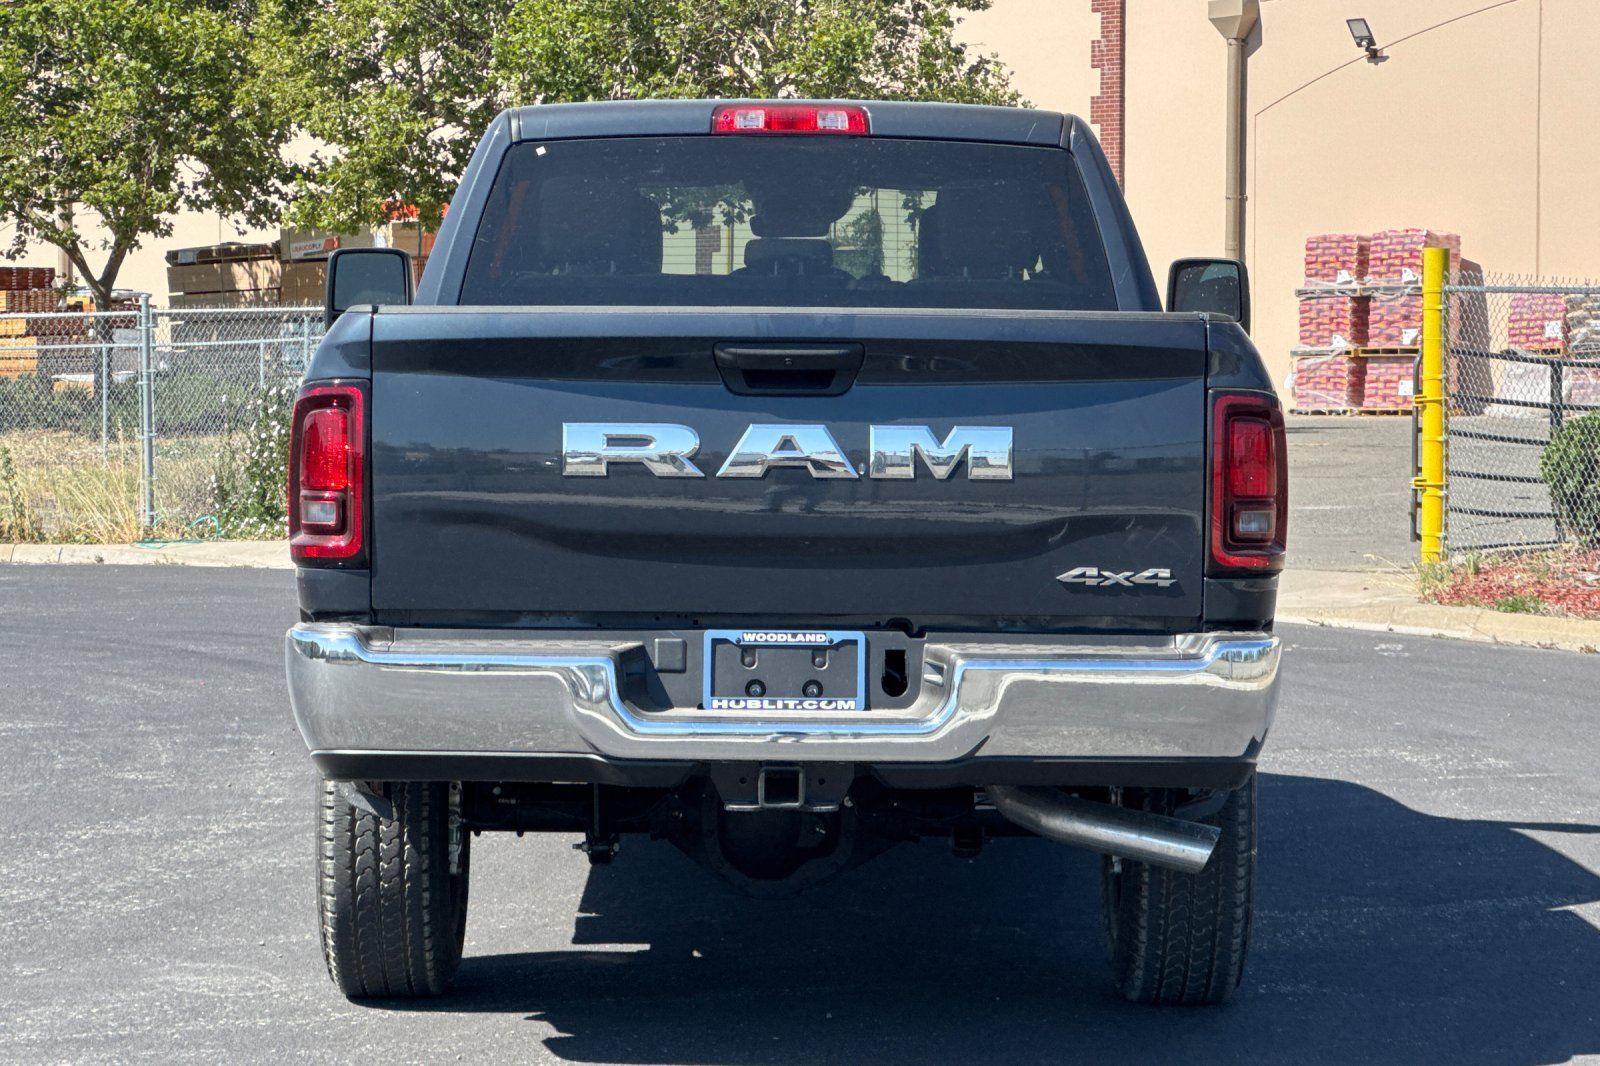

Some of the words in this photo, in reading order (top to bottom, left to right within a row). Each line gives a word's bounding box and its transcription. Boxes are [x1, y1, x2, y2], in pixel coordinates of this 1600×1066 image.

[562, 422, 1014, 480] RAM
[1056, 567, 1178, 587] 4x4
[743, 632, 827, 643] WOODLAND
[712, 699, 856, 710] HUBLIT.COM
